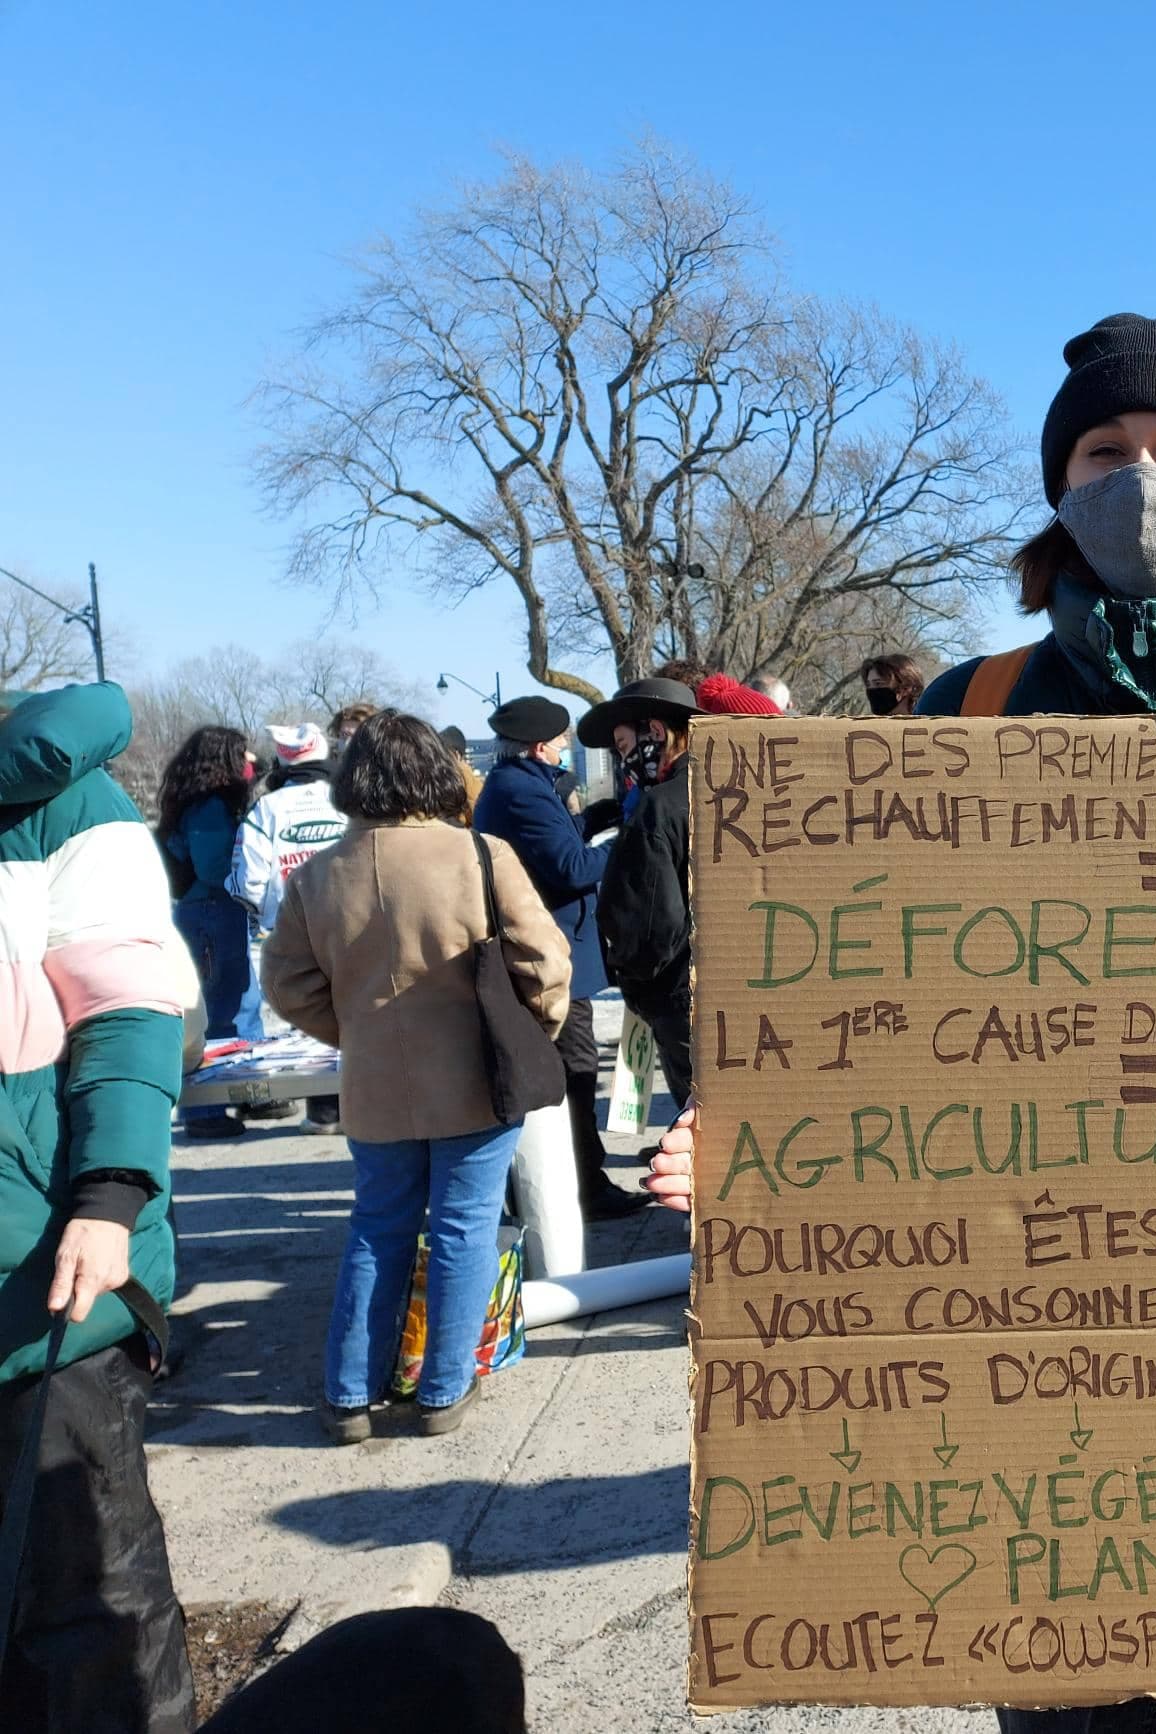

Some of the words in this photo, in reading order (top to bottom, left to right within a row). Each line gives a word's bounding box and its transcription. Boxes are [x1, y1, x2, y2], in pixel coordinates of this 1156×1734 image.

[704, 733, 804, 791] UNE
[845, 727, 970, 785] DES
[716, 1010, 793, 1071] LA
[933, 1003, 1097, 1064] CAUSE
[700, 1217, 969, 1284] POURQUOI
[743, 1292, 874, 1349] VOUS
[701, 1359, 951, 1433] PRODUITS
[699, 1475, 988, 1561] DEVENEZ
[701, 1611, 945, 1687] ECOUTEZ
